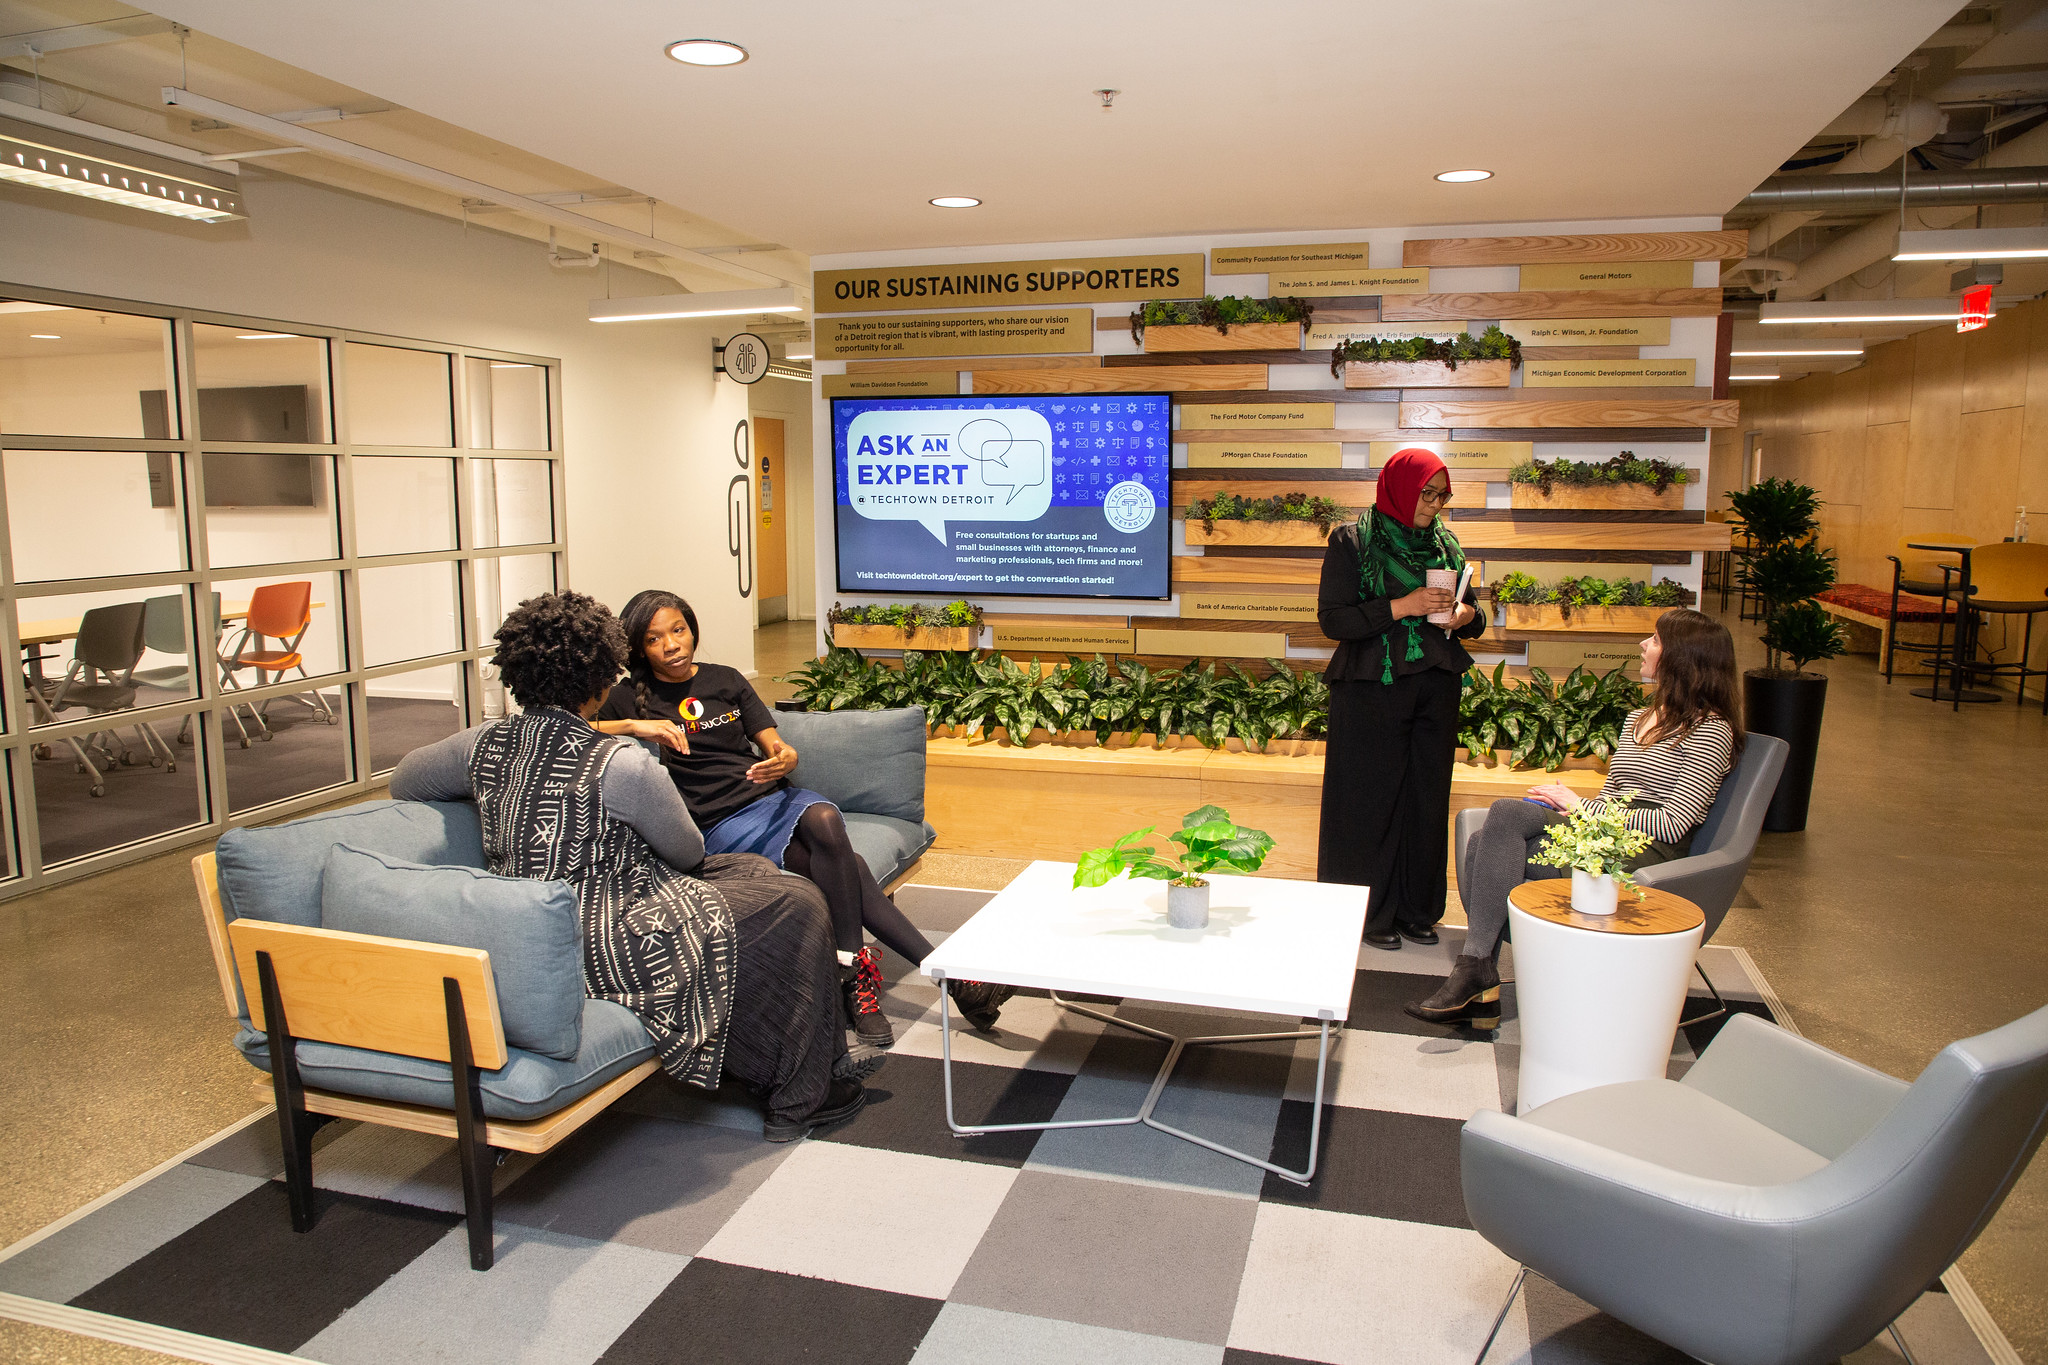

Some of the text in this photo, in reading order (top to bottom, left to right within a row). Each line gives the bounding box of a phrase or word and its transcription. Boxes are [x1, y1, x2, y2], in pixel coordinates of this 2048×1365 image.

[1216, 252, 1364, 264] Community Foundation for Southeast Michigan
[834, 267, 1180, 300] OUR SUSTAINING SUPPORTERS
[1291, 280, 1307, 288] John
[1359, 278, 1381, 287] Knight
[1382, 277, 1419, 285] Foundation
[838, 322, 861, 331] Thank
[862, 323, 876, 332] you
[901, 320, 941, 329] sustaining
[942, 319, 987, 328] supporters,
[988, 317, 1005, 326] who
[1006, 316, 1028, 325] share
[1045, 315, 1069, 324] vision
[835, 333, 844, 341] of
[850, 333, 877, 341] Detroit
[878, 332, 902, 342] region
[903, 331, 920, 339] that
[921, 331, 927, 339] is
[929, 330, 958, 339] vibrant,
[960, 329, 976, 338] with
[978, 328, 1005, 338] lasting
[1006, 327, 1048, 337] prosperity
[1049, 326, 1065, 335] and
[1399, 331, 1421, 339] Family
[1531, 329, 1551, 338] Ralph
[1561, 329, 1587, 337] Wilson,
[1588, 328, 1597, 336] Jr.
[835, 342, 905, 353] opportunity for all.
[1531, 370, 1562, 378] Michigan
[1598, 369, 1644, 378] Development
[1645, 369, 1687, 377] Corporation
[1258, 413, 1287, 421] Company
[856, 434, 948, 456] ASK AN
[857, 464, 969, 485] EXPERT
[871, 495, 937, 504] TECHTOWN
[942, 495, 995, 504] DETROIT
[1111, 487, 1148, 503] TECHTOWN
[1114, 515, 1146, 527] DETROIT
[955, 531, 1098, 541] Free consultations for startups and
[955, 543, 977, 551] small
[978, 544, 1023, 552] businesses
[1024, 544, 1042, 552] with
[1043, 544, 1086, 554] attorneys,
[1087, 545, 1119, 553] finance
[955, 555, 1143, 566] marketing professionals, tech firms and more!
[856, 571, 874, 579] Visit
[875, 572, 983, 582] techtowndetroit.org/expert
[984, 574, 993, 582] to
[995, 574, 1010, 583] get
[1026, 575, 1080, 584] conversation
[1081, 576, 1115, 584] started!
[1280, 605, 1315, 613] Foundation
[1010, 635, 1044, 643] Department
[1600, 652, 1640, 660] Corporation
